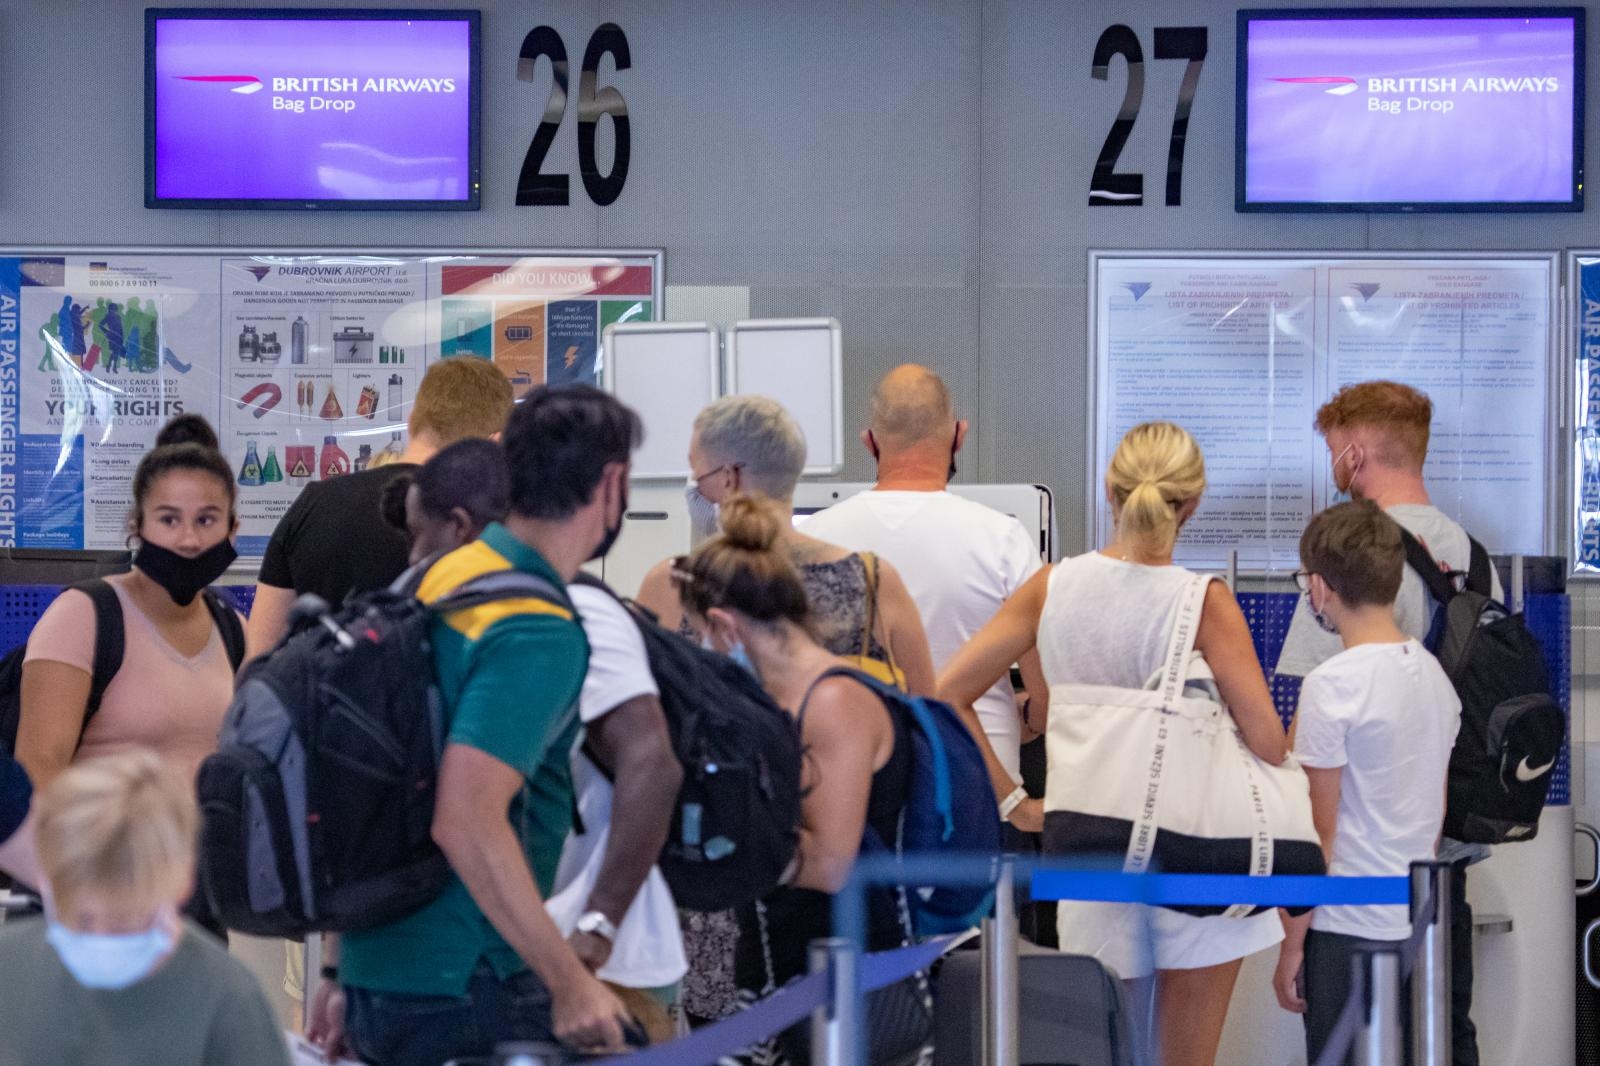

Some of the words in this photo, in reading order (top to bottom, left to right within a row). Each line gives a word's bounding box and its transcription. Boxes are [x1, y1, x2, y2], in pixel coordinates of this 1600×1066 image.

[272, 77, 358, 92] BRITISH
[363, 77, 456, 92] AIRWAYS
[1367, 77, 1457, 92] BRITISH
[1462, 77, 1559, 92] AIRWAYS
[272, 96, 305, 112] Bag
[310, 96, 356, 112] Drop
[515, 22, 631, 206] 26
[1088, 23, 1208, 206] 27
[1367, 97, 1401, 113] Bag
[1407, 97, 1454, 113] Drop
[278, 266, 342, 276] DUBROVNIK
[492, 272, 516, 284] DID
[518, 272, 545, 284] YOU
[0, 294, 16, 333] AIR
[1168, 302, 1184, 310] LIST
[1584, 299, 1600, 338] AIR
[0, 339, 16, 467] PASSENGER
[114, 400, 184, 416] RIGHTS
[0, 473, 16, 548] RIGHTS
[1168, 623, 1190, 683] BATIGNOLLES
[1140, 782, 1160, 822] SERVICE
[1250, 784, 1264, 813] PARIS
[1136, 821, 1152, 852] LIBRE
[1258, 831, 1266, 843] LE
[1132, 853, 1144, 868] LE
[1257, 845, 1266, 875] LIBRE
